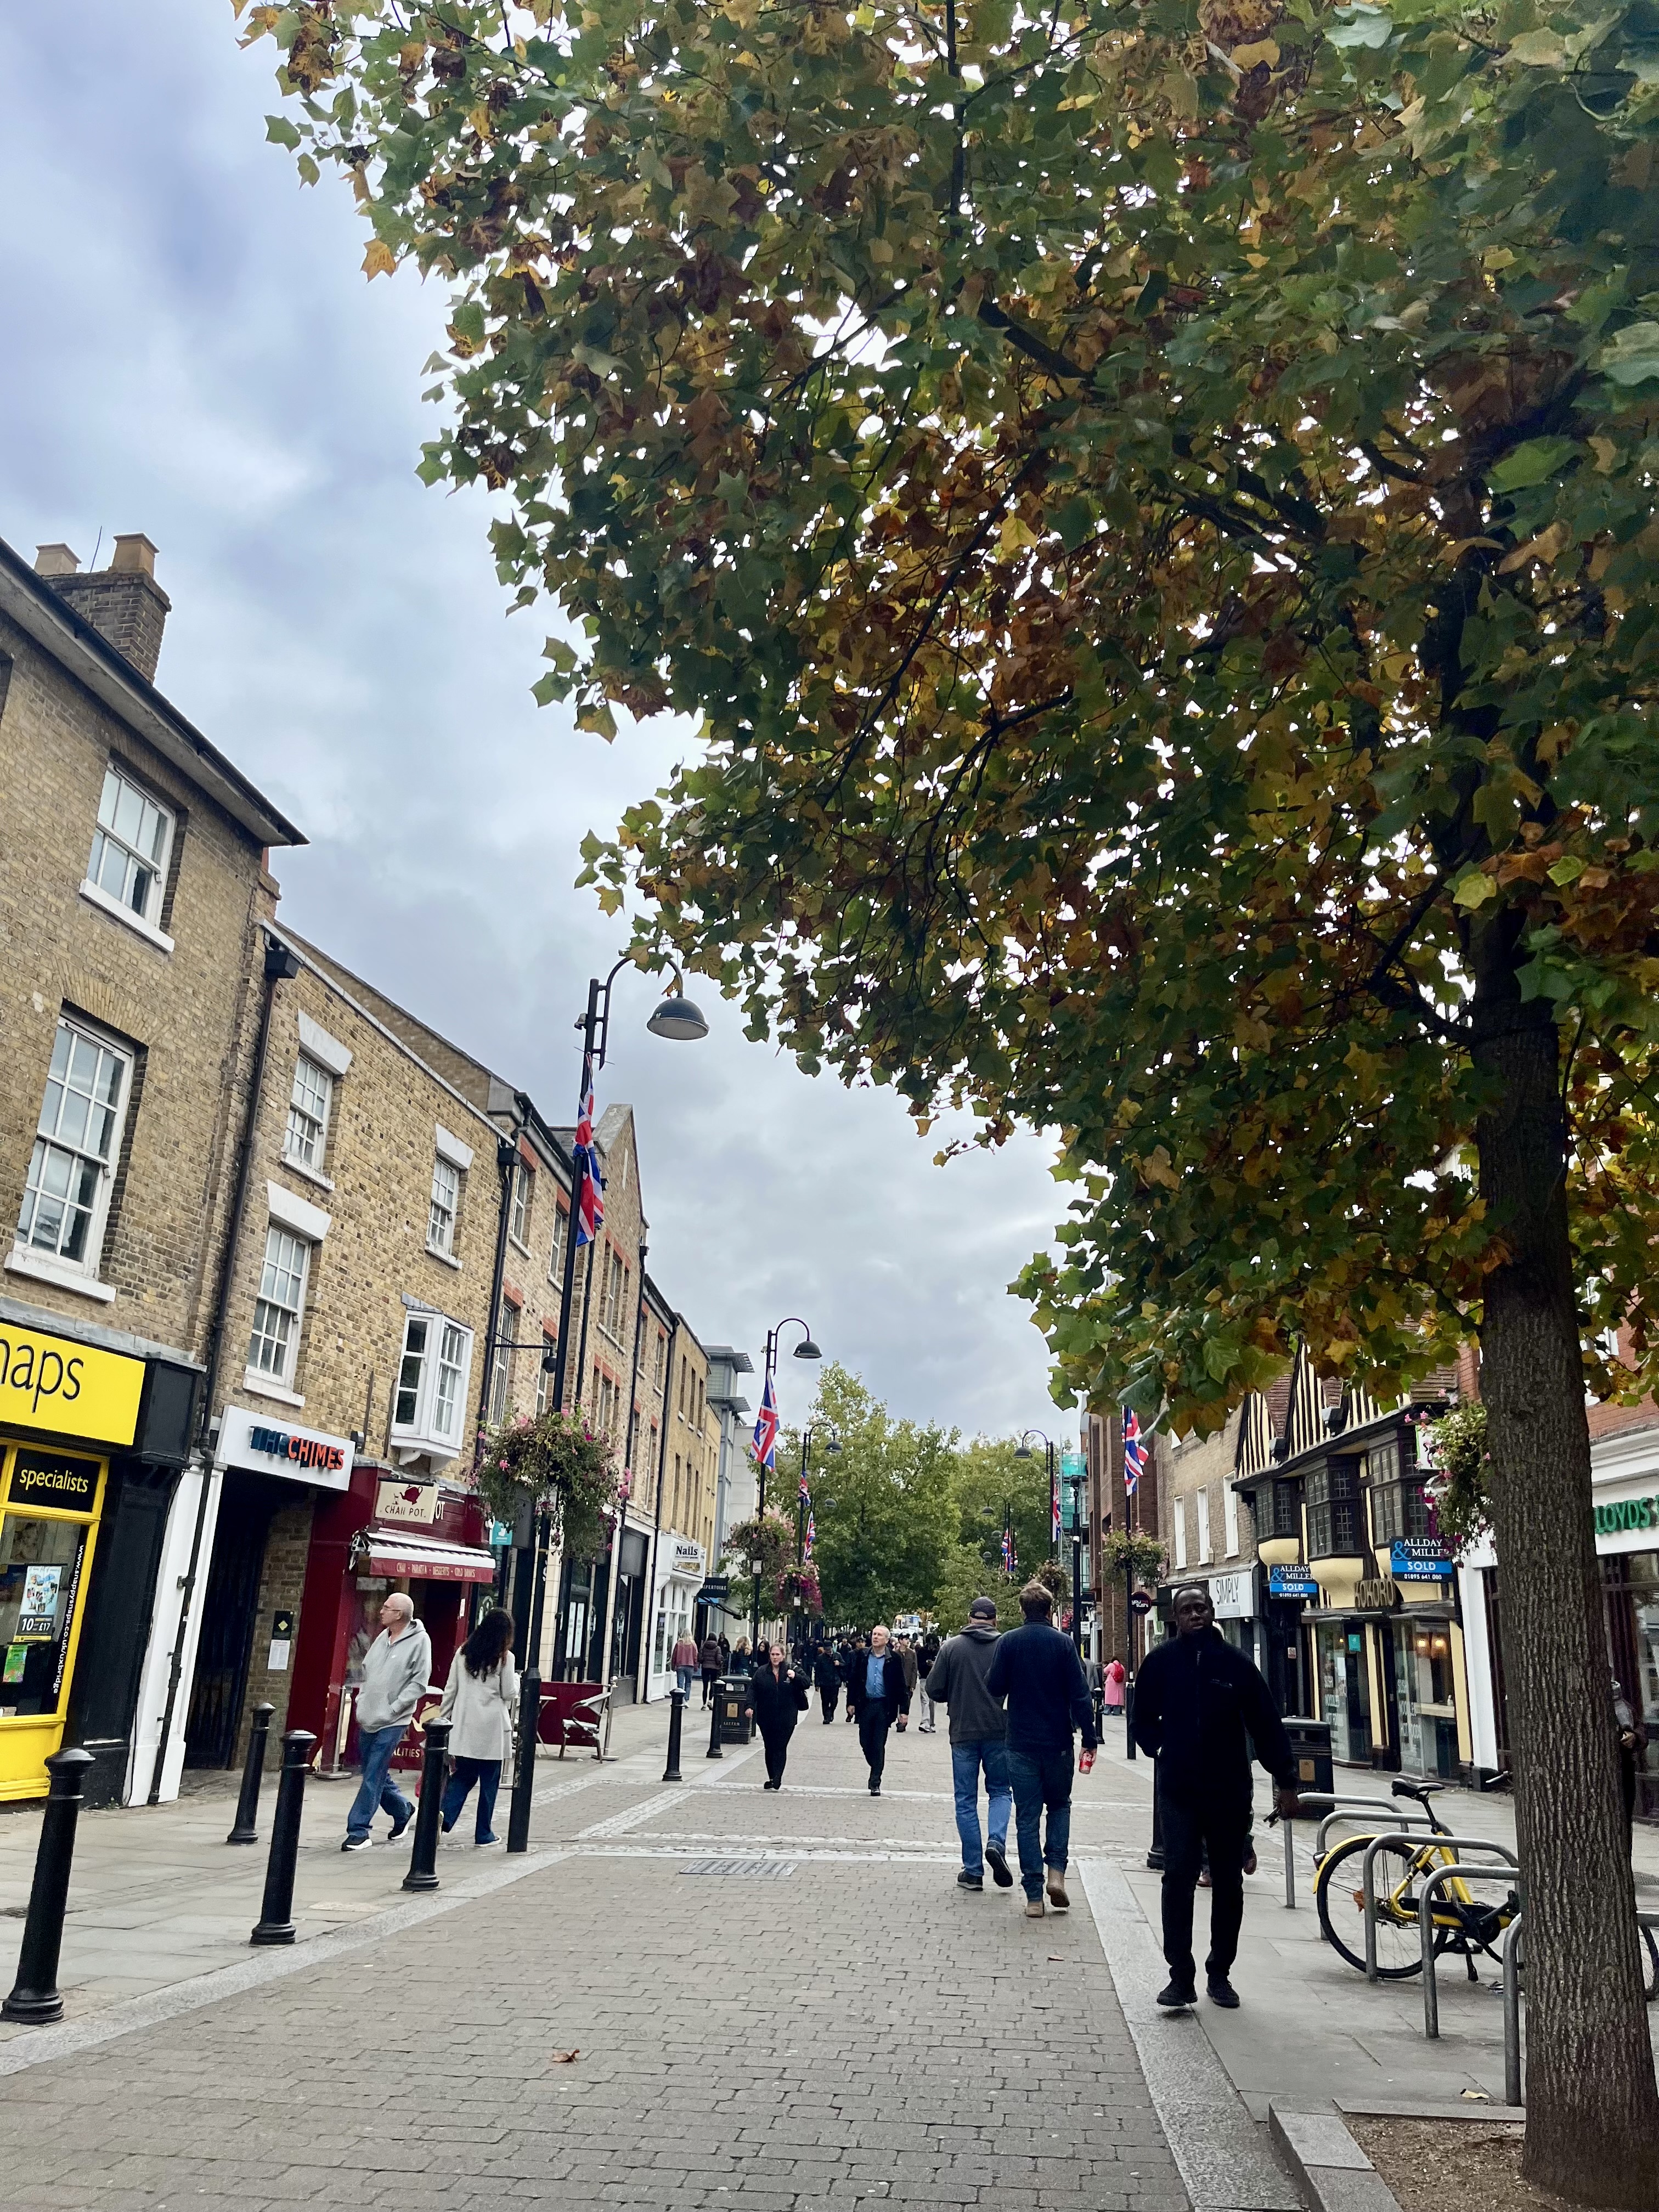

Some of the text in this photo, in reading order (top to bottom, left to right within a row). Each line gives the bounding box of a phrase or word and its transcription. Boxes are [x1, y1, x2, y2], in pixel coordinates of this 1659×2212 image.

[249, 1425, 345, 1470] THE CHIMES
[19, 1469, 89, 1493] specialists
[435, 1500, 445, 1520] OT
[1594, 1497, 1651, 1534] LOYDS
[675, 1545, 698, 1556] Nails
[1404, 1538, 1442, 1547] ALLDAY
[1408, 1561, 1436, 1571] SOLD
[1216, 1576, 1239, 1605] SIMPLY
[1282, 1583, 1304, 1591] SOLD
[1355, 1578, 1396, 1609] KOKORO
[21, 1618, 34, 1632] 10
[38, 1622, 51, 1632] £17
